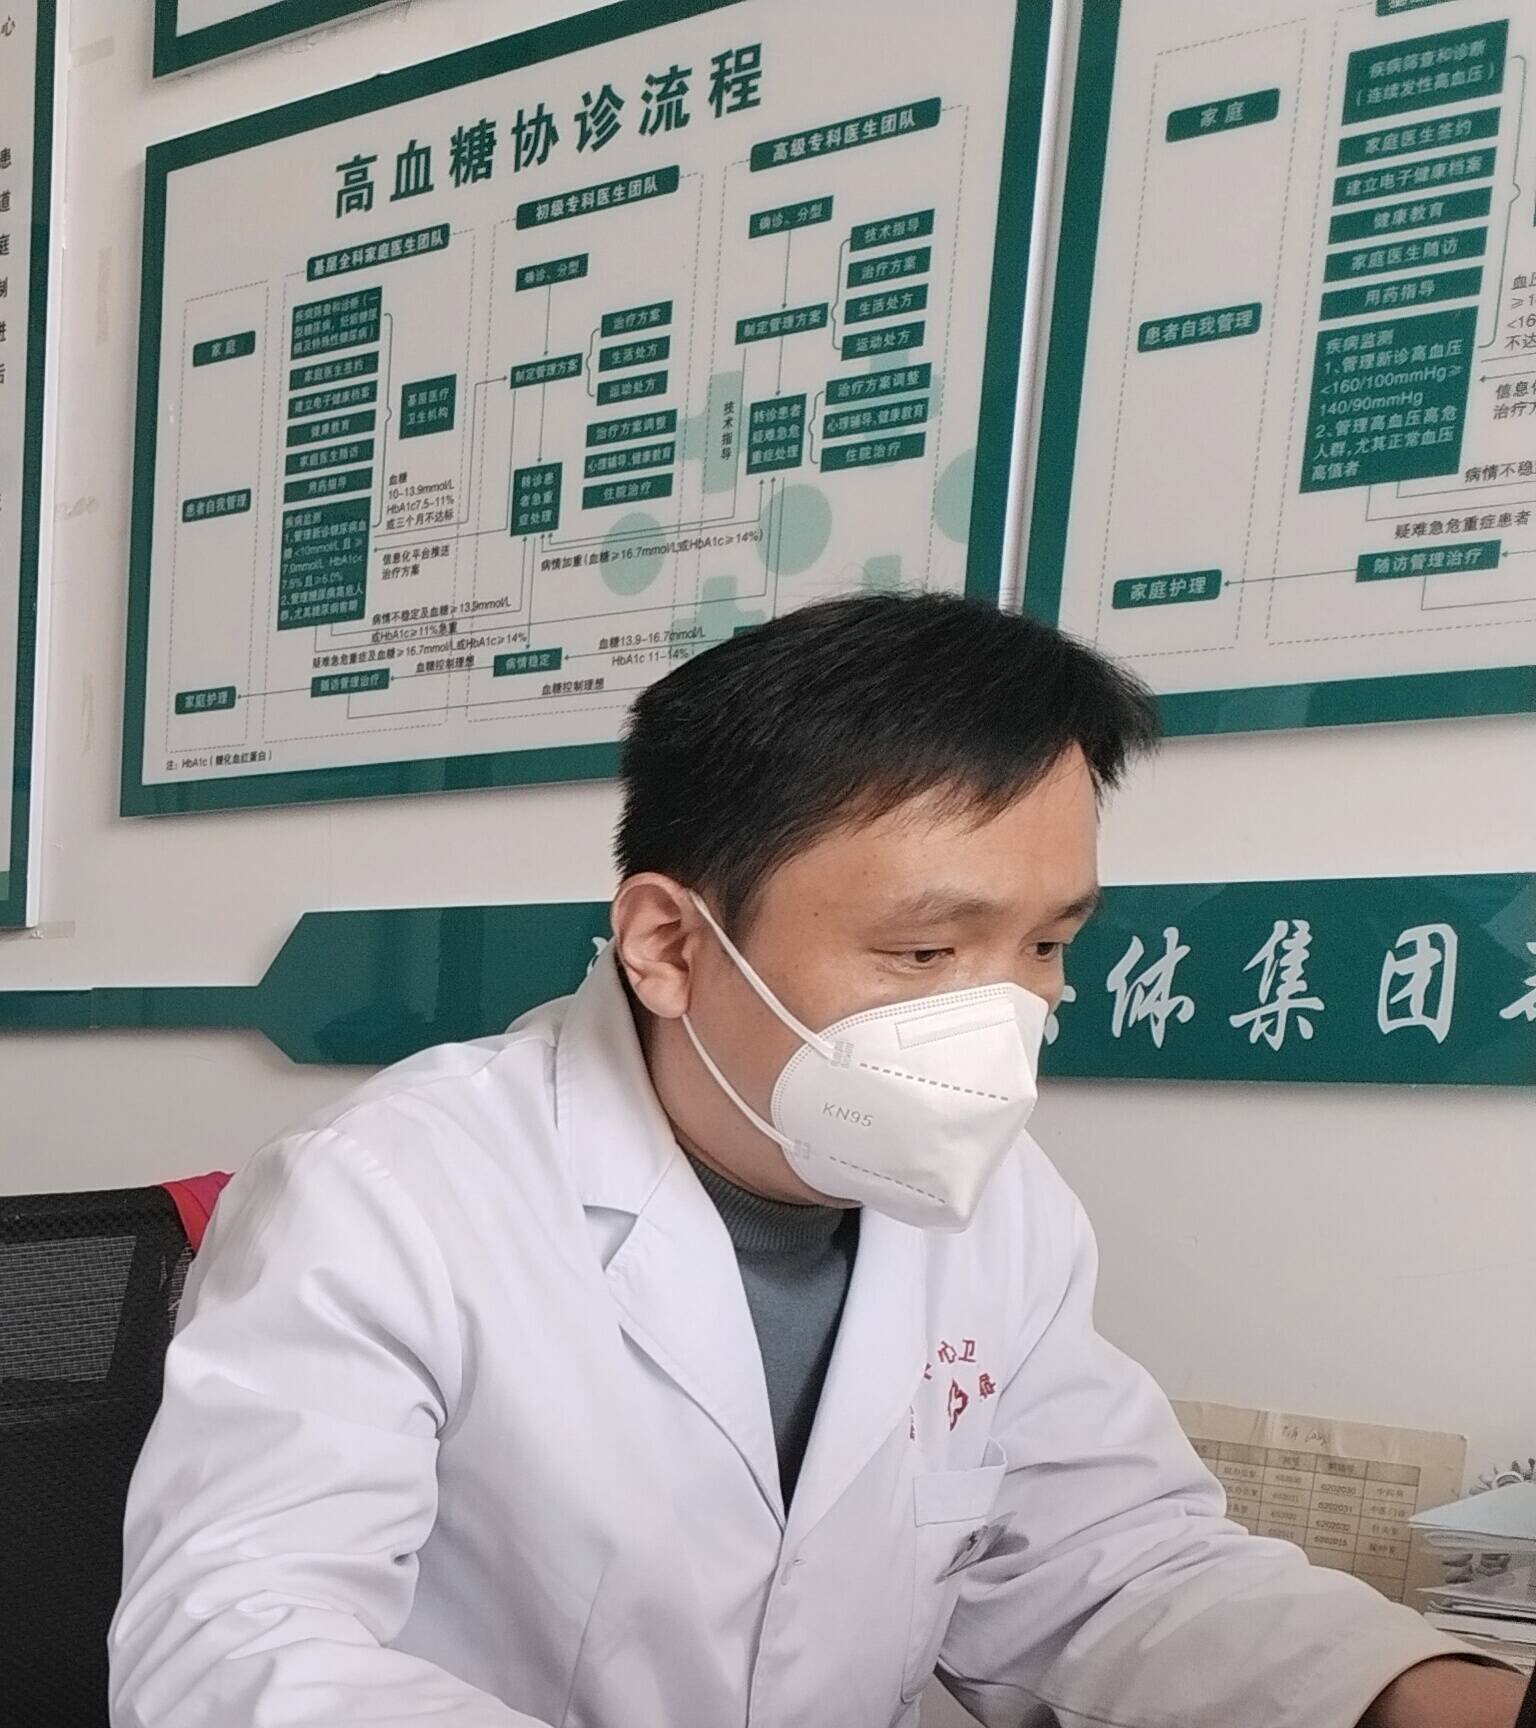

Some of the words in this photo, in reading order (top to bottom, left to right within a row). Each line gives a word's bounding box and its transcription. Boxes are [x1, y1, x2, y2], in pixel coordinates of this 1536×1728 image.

[1369, 38, 1488, 80] 疾病筛查和诊断
[1198, 99, 1246, 130] 家庭
[334, 42, 763, 218] 高血糖协诊流程
[772, 108, 916, 162] 高级专科医生团队
[1365, 118, 1473, 155] 家庭医生签约
[1344, 155, 1484, 198] 建立电子健康档案
[536, 175, 659, 221] 初级专科医生团队
[1373, 201, 1445, 230] 健康教育
[864, 217, 920, 243] 技术指导
[313, 228, 445, 276] 基层全科家庭医生团队
[1351, 238, 1460, 272] 家庭医生随访
[860, 254, 918, 280] 治疗方案
[858, 292, 914, 317] 生活处方
[1363, 279, 1437, 307] 用药指导
[612, 308, 661, 331] 治疗方案
[743, 310, 823, 337] 制定管理方案
[1142, 310, 1255, 347] 患者自我管理
[612, 343, 659, 366] 生活处方
[855, 329, 911, 354] 运动处方
[1325, 329, 1395, 355] 疾病监测
[514, 357, 579, 383] 制定管理方案
[1324, 338, 1464, 376] 1、管理新诊高血压
[837, 370, 922, 398] 治疗方案调整
[1319, 390, 1425, 417] 140/90mmHg
[595, 415, 667, 440] 治疗方案调整
[721, 400, 735, 461] 技术指导
[1315, 404, 1459, 440] 2、管理高血压高危
[844, 441, 902, 463] 住院治疗
[388, 472, 408, 486] 血糖
[1310, 460, 1361, 482] 高值者
[603, 481, 652, 501] 住院治疗
[184, 494, 247, 520] 患者自我管理
[385, 510, 455, 531] 或三个月不达标
[1394, 509, 1532, 540] 疑难急危重症患者
[382, 545, 450, 566] 信息化平台推送
[1373, 547, 1484, 575] 随访管理治疗
[381, 562, 421, 581] 治疗方案
[1129, 576, 1209, 603] 家庭护理
[415, 654, 476, 674] 血糖控制理想
[505, 654, 552, 672] 病情稳定
[184, 690, 229, 709] 家庭护理
[541, 677, 606, 697] 血糖控制理想
[1040, 919, 1536, 1053] 体集团
[822, 1102, 874, 1128] KN95
